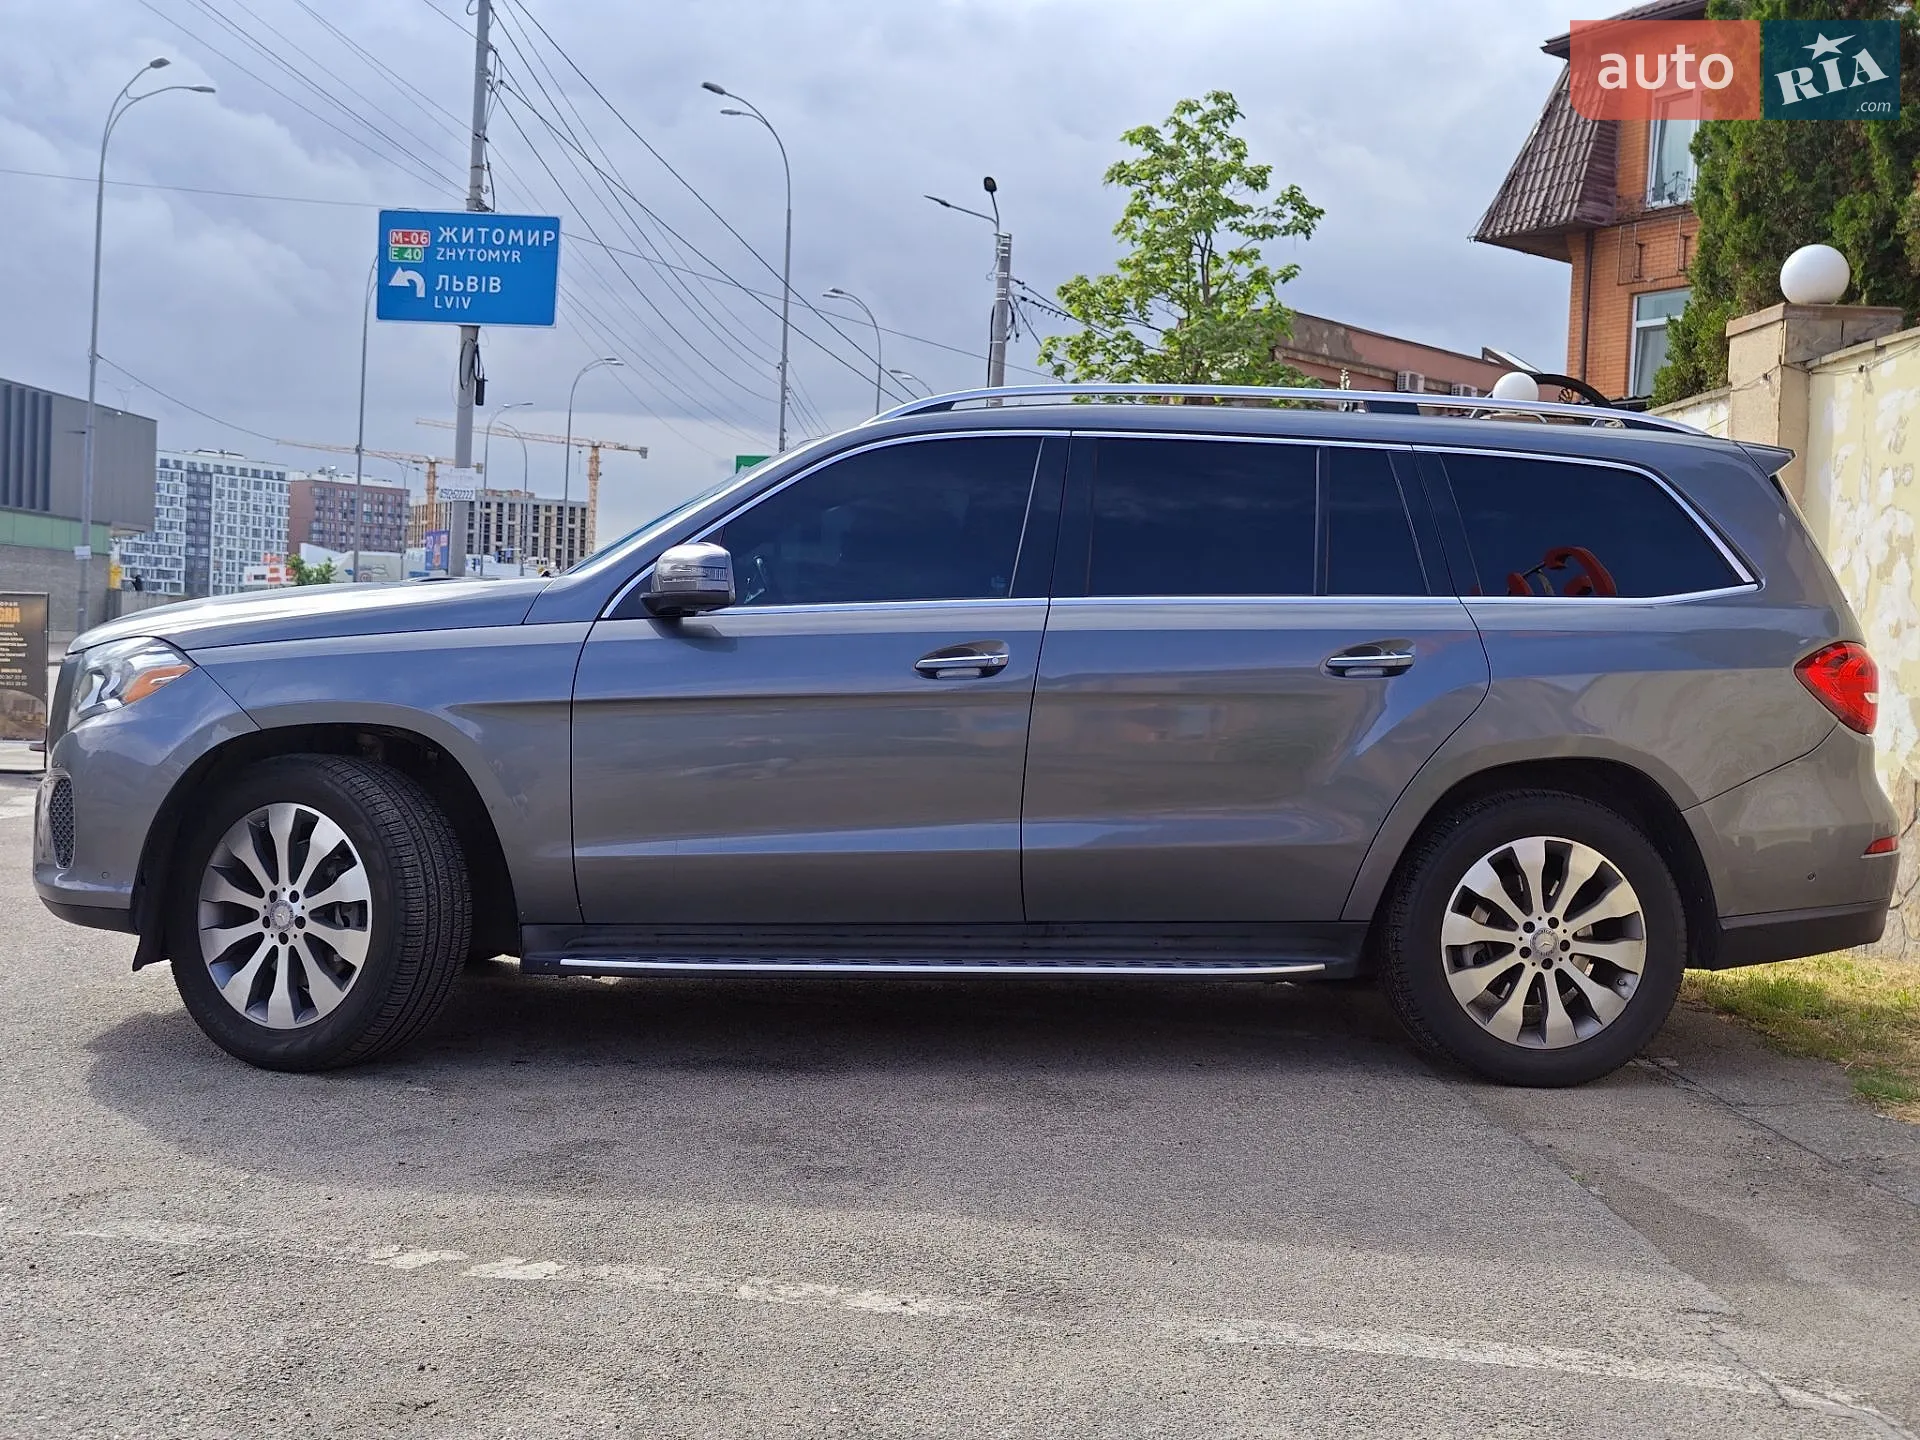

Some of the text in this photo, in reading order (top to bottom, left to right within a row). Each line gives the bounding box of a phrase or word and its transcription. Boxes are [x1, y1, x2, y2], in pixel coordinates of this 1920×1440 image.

[437, 226, 556, 247] ЖИТОМИР
[391, 247, 422, 260] E 40
[436, 247, 521, 263] ZHYTOMYR
[435, 274, 501, 293] ЛЬВІВ
[434, 296, 471, 310] LVIV
